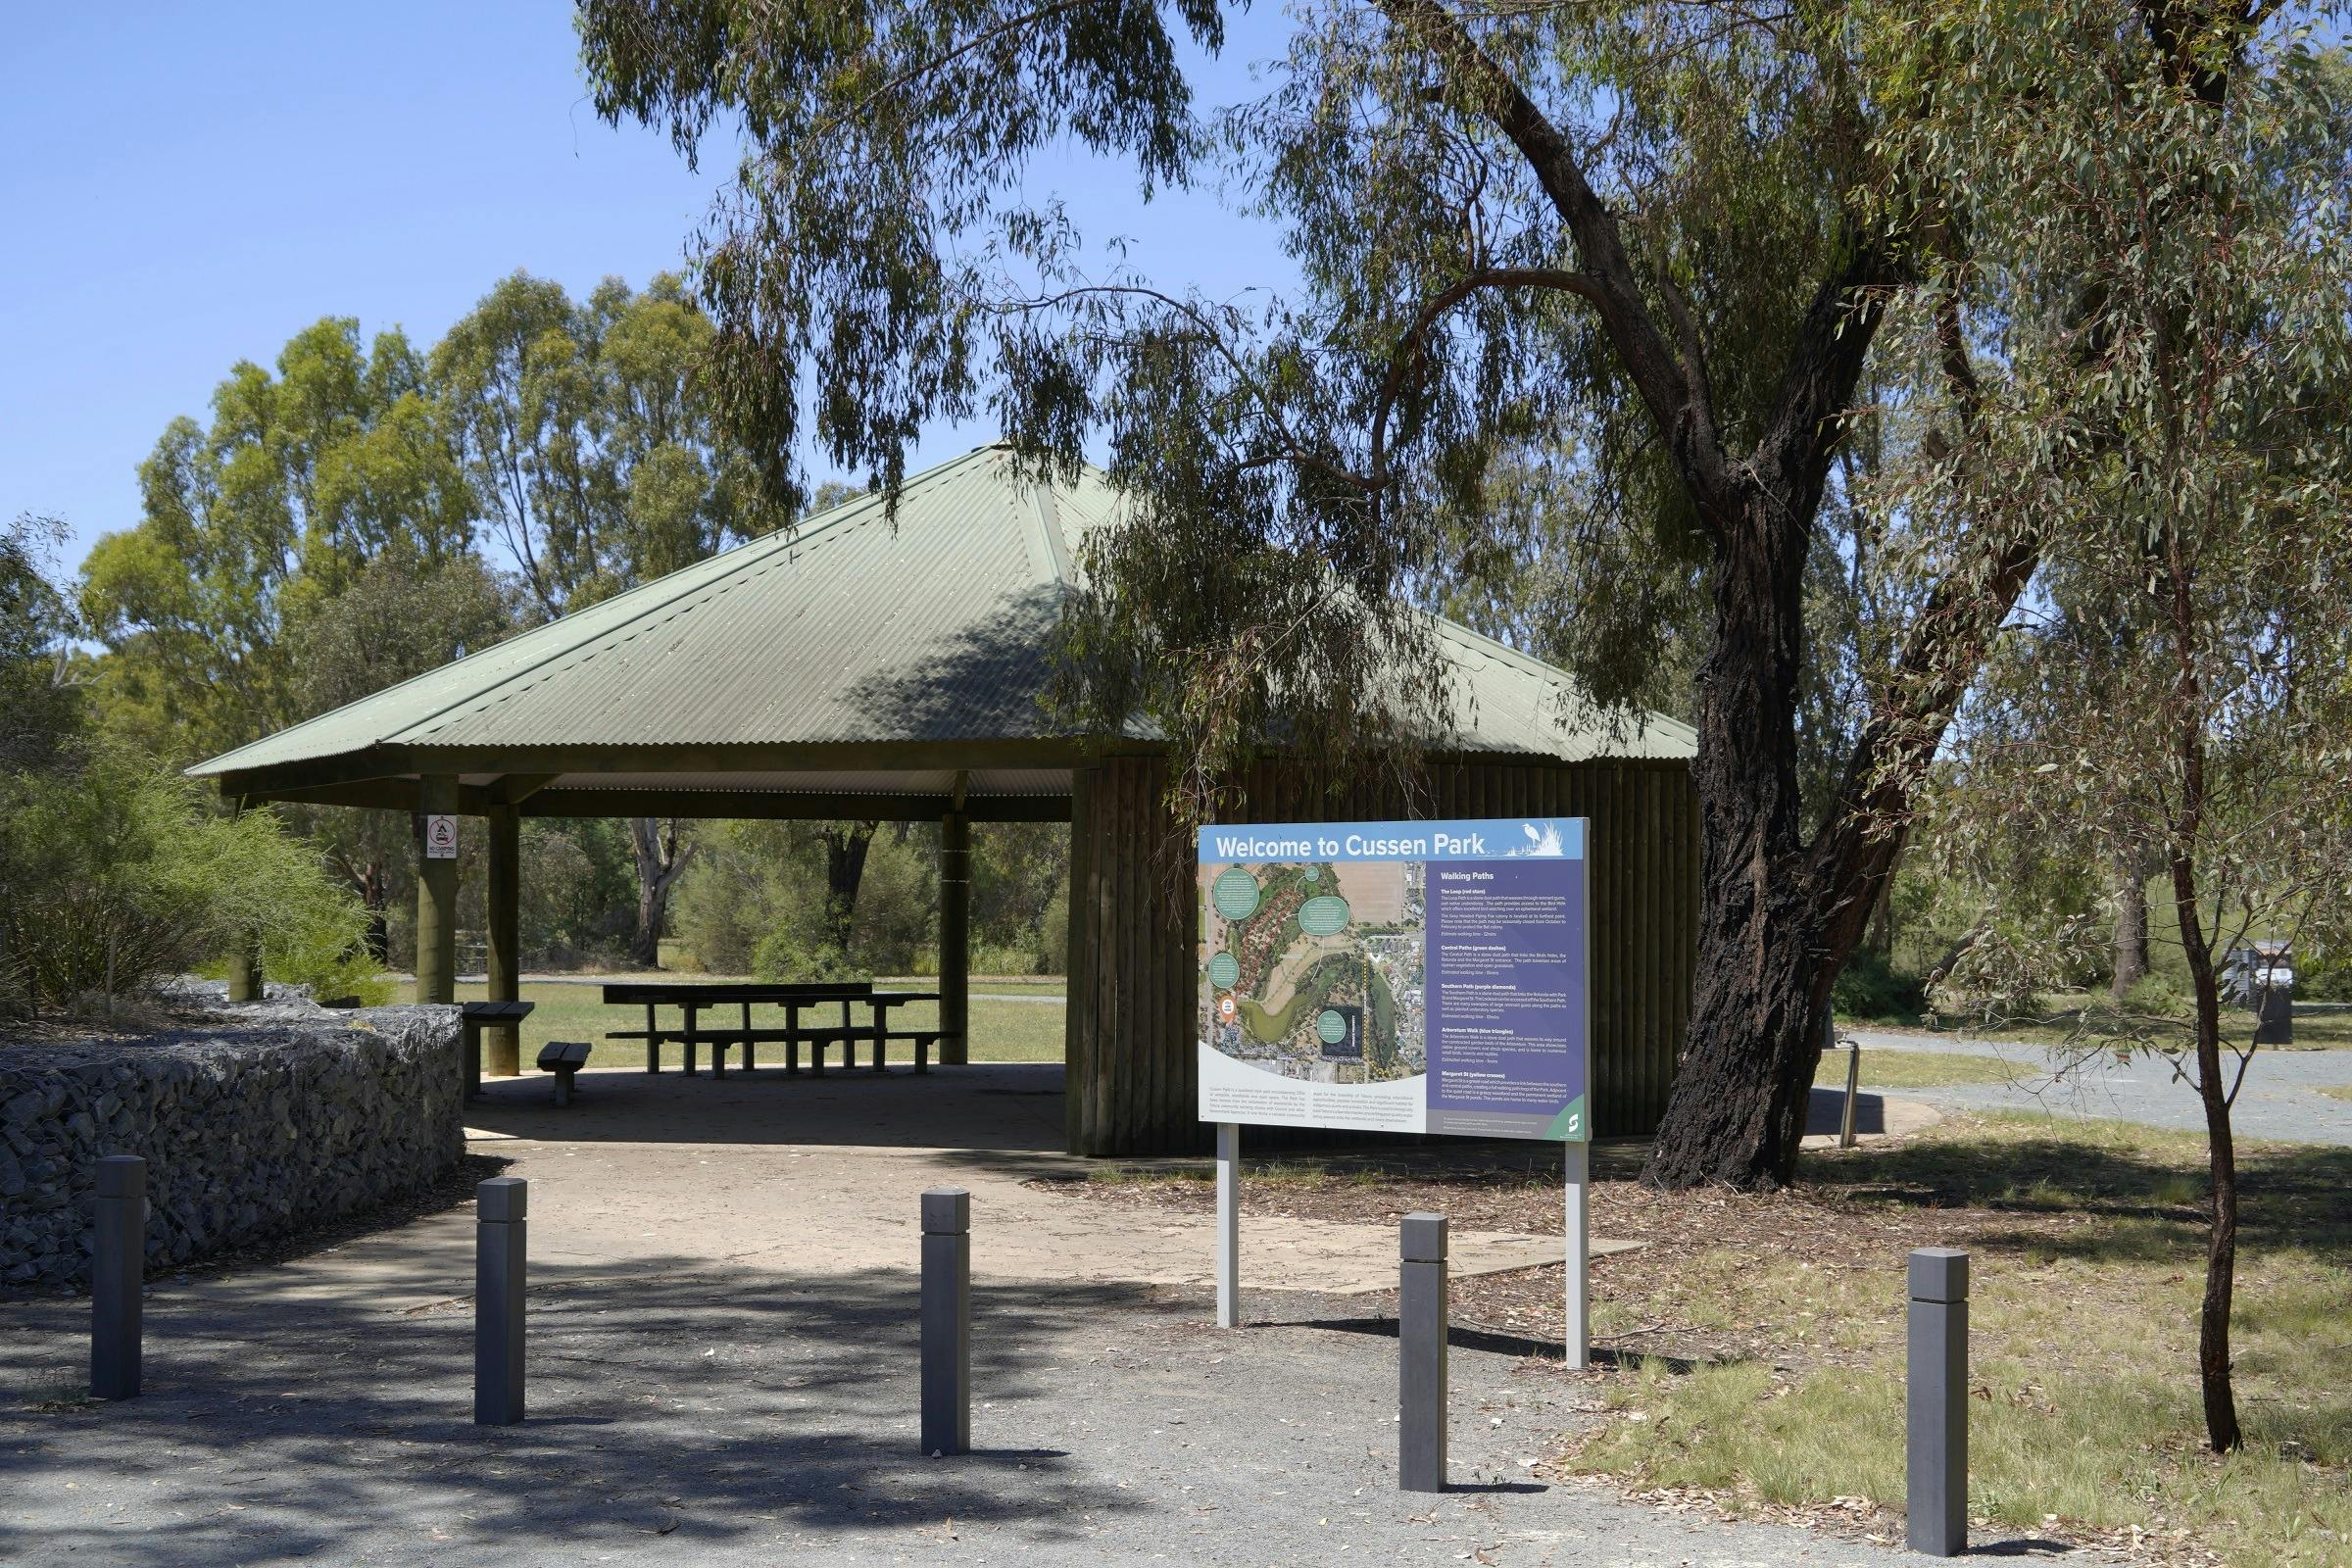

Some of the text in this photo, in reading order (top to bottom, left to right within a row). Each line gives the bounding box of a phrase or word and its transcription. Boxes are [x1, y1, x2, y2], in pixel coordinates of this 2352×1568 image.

[1216, 833, 1486, 858] Welcome to Cussen Park
[1441, 872, 1494, 882] Walking Paths
